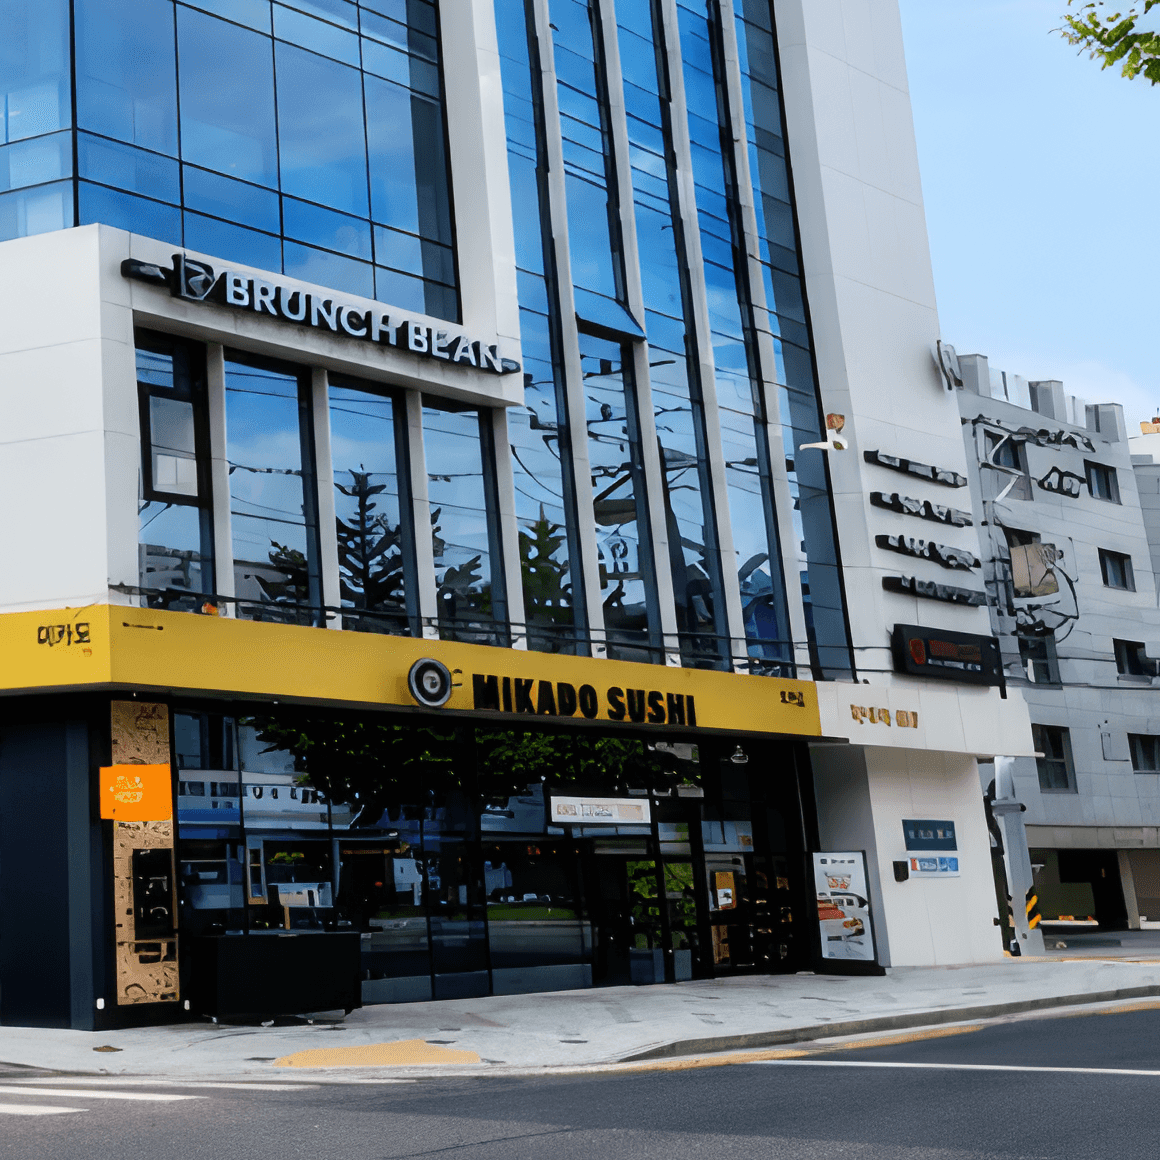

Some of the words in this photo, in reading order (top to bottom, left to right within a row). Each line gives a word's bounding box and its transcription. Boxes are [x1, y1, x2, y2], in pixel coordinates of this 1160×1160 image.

[225, 271, 400, 348] BRUNCH
[406, 319, 504, 374] BEAN
[472, 673, 598, 720] MIKADO
[606, 686, 697, 727] SUSHI
